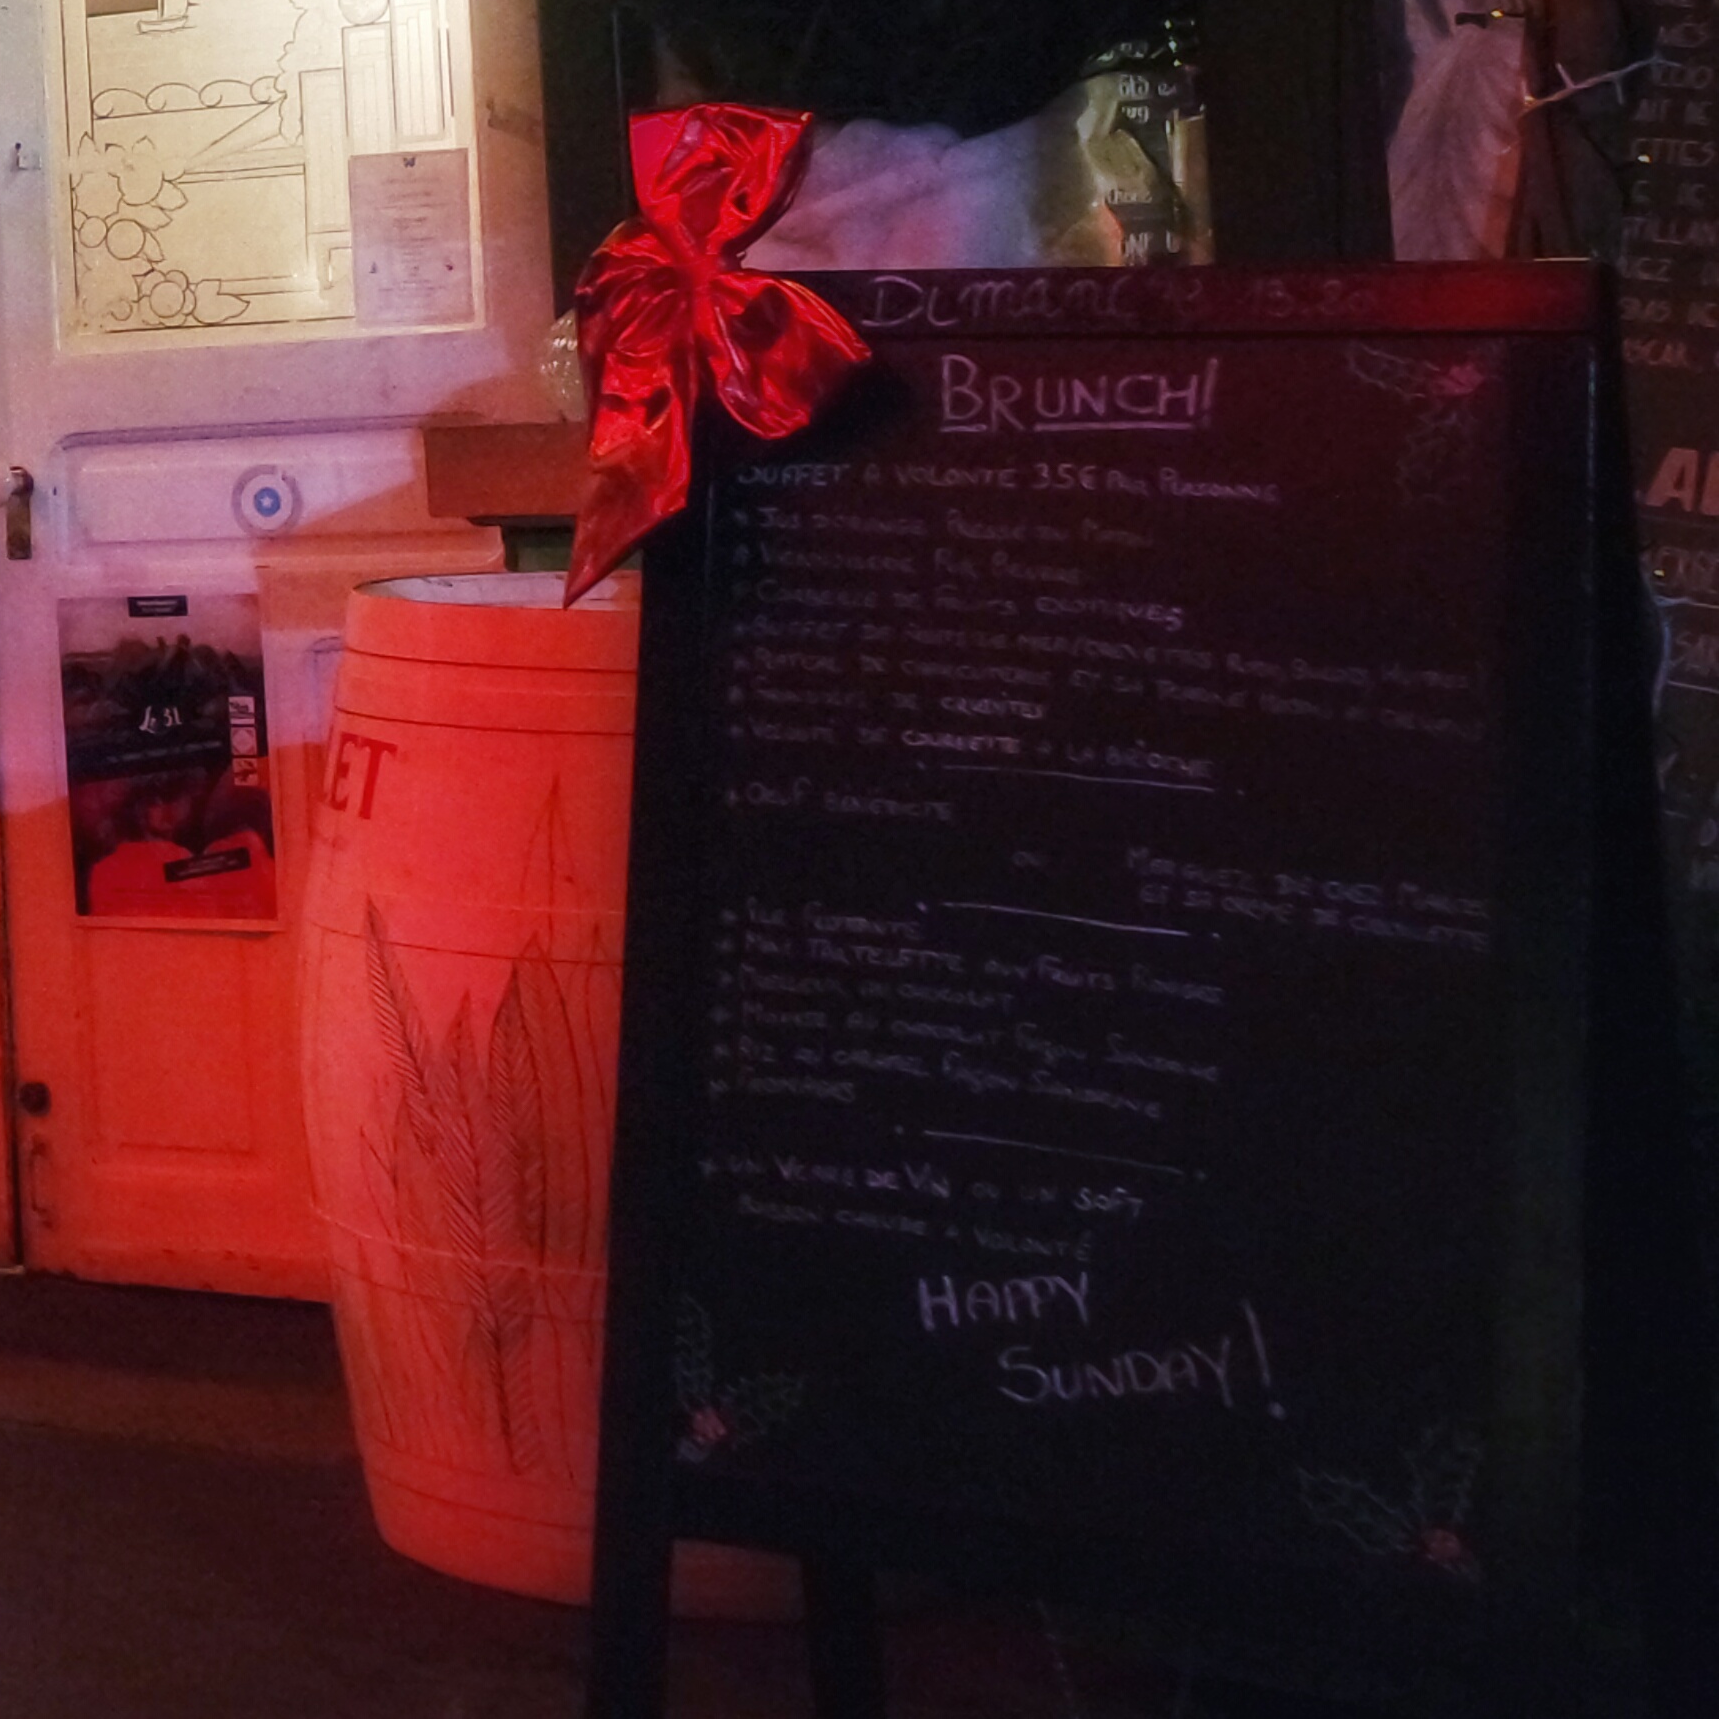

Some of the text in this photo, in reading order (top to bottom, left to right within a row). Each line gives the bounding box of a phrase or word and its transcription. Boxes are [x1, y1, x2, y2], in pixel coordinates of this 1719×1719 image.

[941, 355, 1219, 429] BRUNCH!
[917, 1270, 1090, 1331] HAPPY
[997, 1298, 1287, 1421] SUNDAY!
